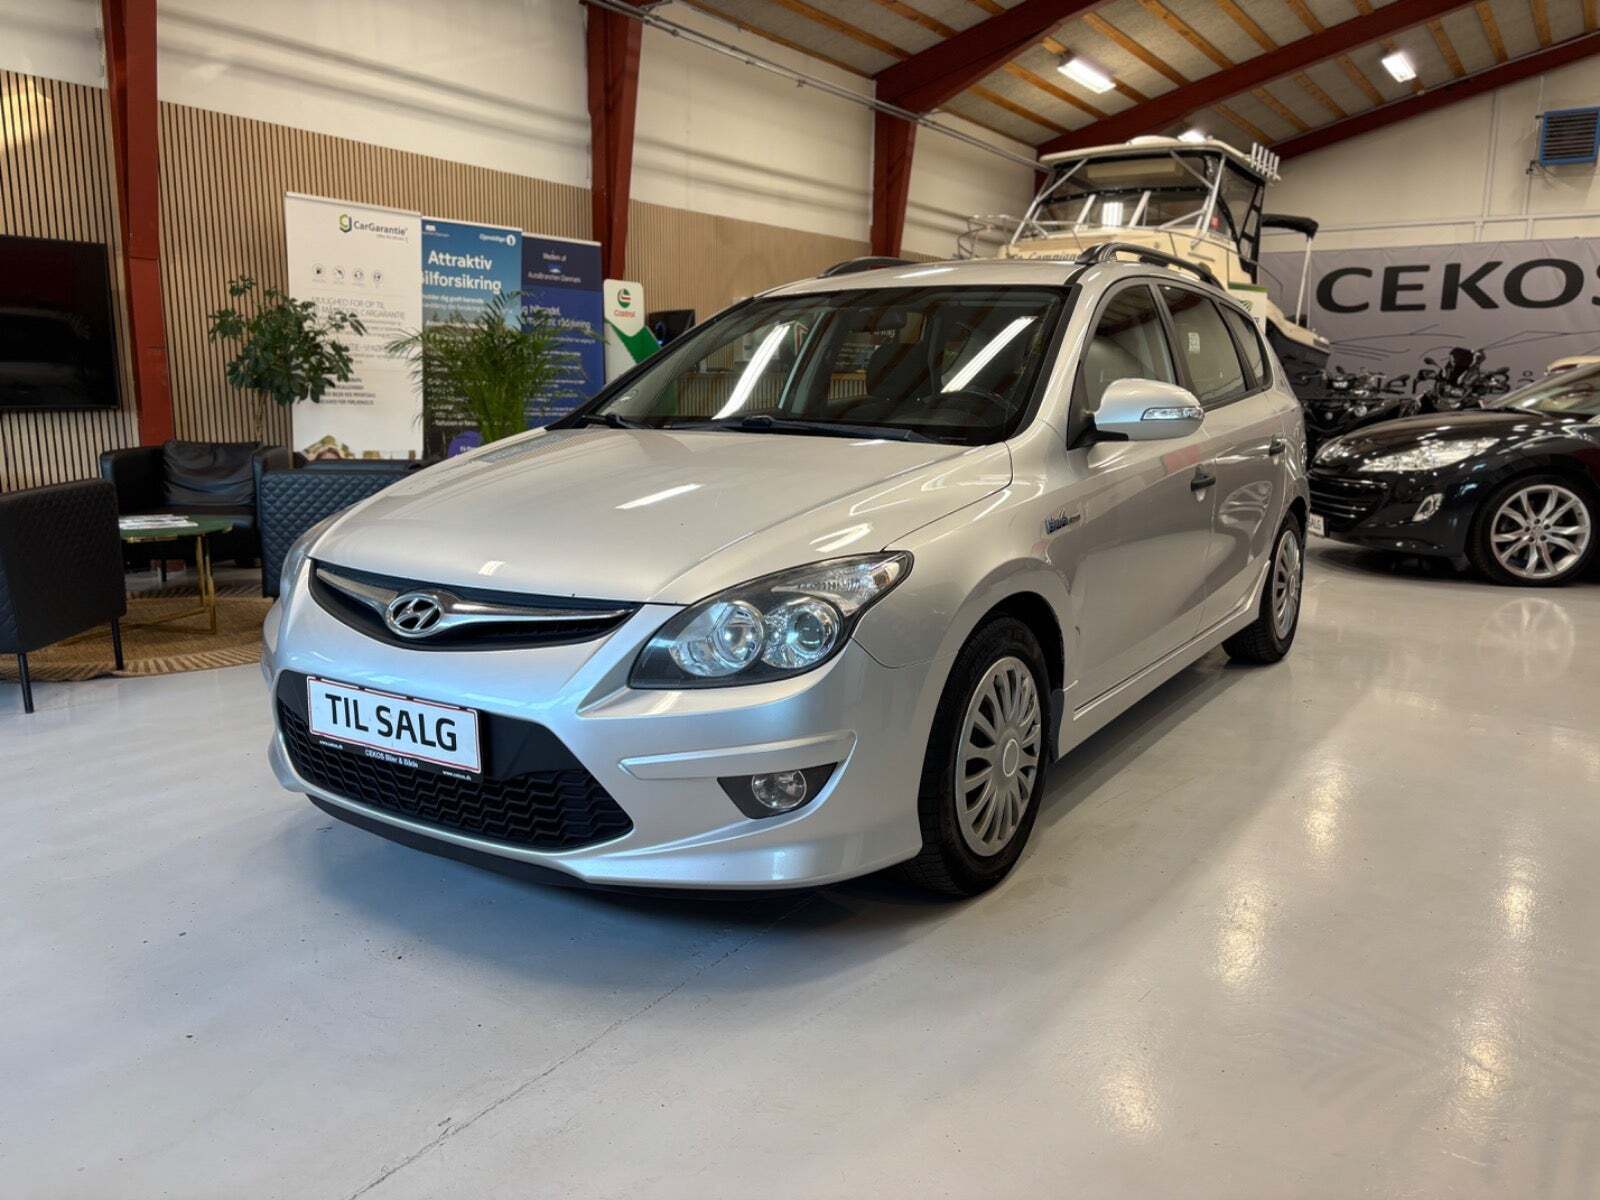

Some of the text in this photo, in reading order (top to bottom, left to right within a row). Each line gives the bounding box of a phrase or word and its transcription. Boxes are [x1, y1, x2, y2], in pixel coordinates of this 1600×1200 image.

[353, 220, 408, 236] CarGarantie
[428, 249, 492, 271] Attraktiv
[1316, 258, 1600, 314] CEKO
[325, 693, 457, 751] TIL SALG
[364, 749, 385, 760] CEKOS
